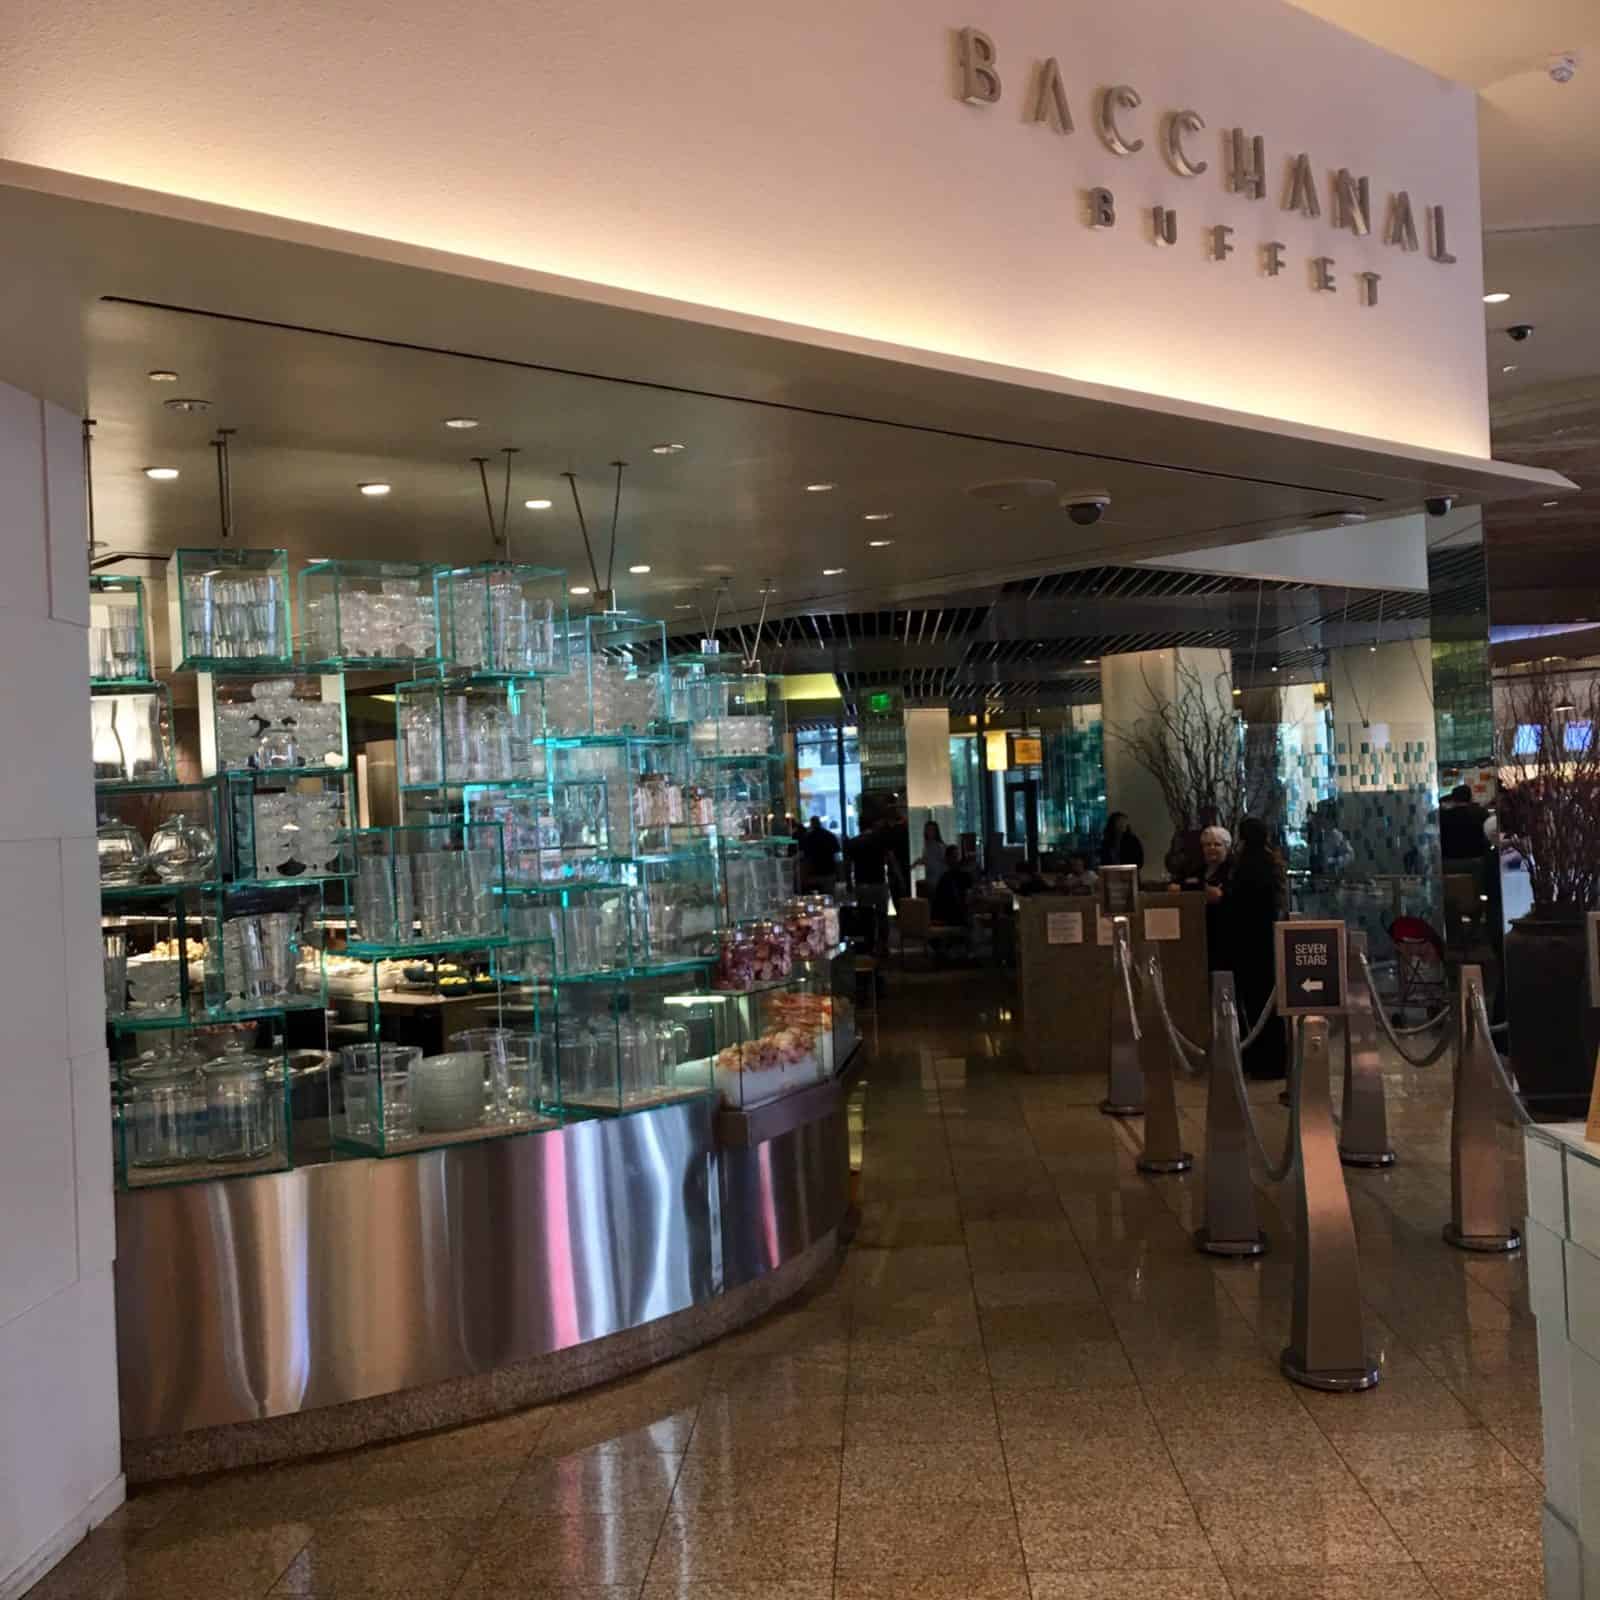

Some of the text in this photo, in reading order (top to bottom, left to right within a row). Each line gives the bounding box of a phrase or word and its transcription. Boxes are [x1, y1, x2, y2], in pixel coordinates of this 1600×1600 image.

[955, 25, 1456, 264] BACCHANAL
[1084, 186, 1381, 306] BUFFET
[1295, 943, 1327, 954] SEVEN
[1295, 955, 1327, 966] STARS
